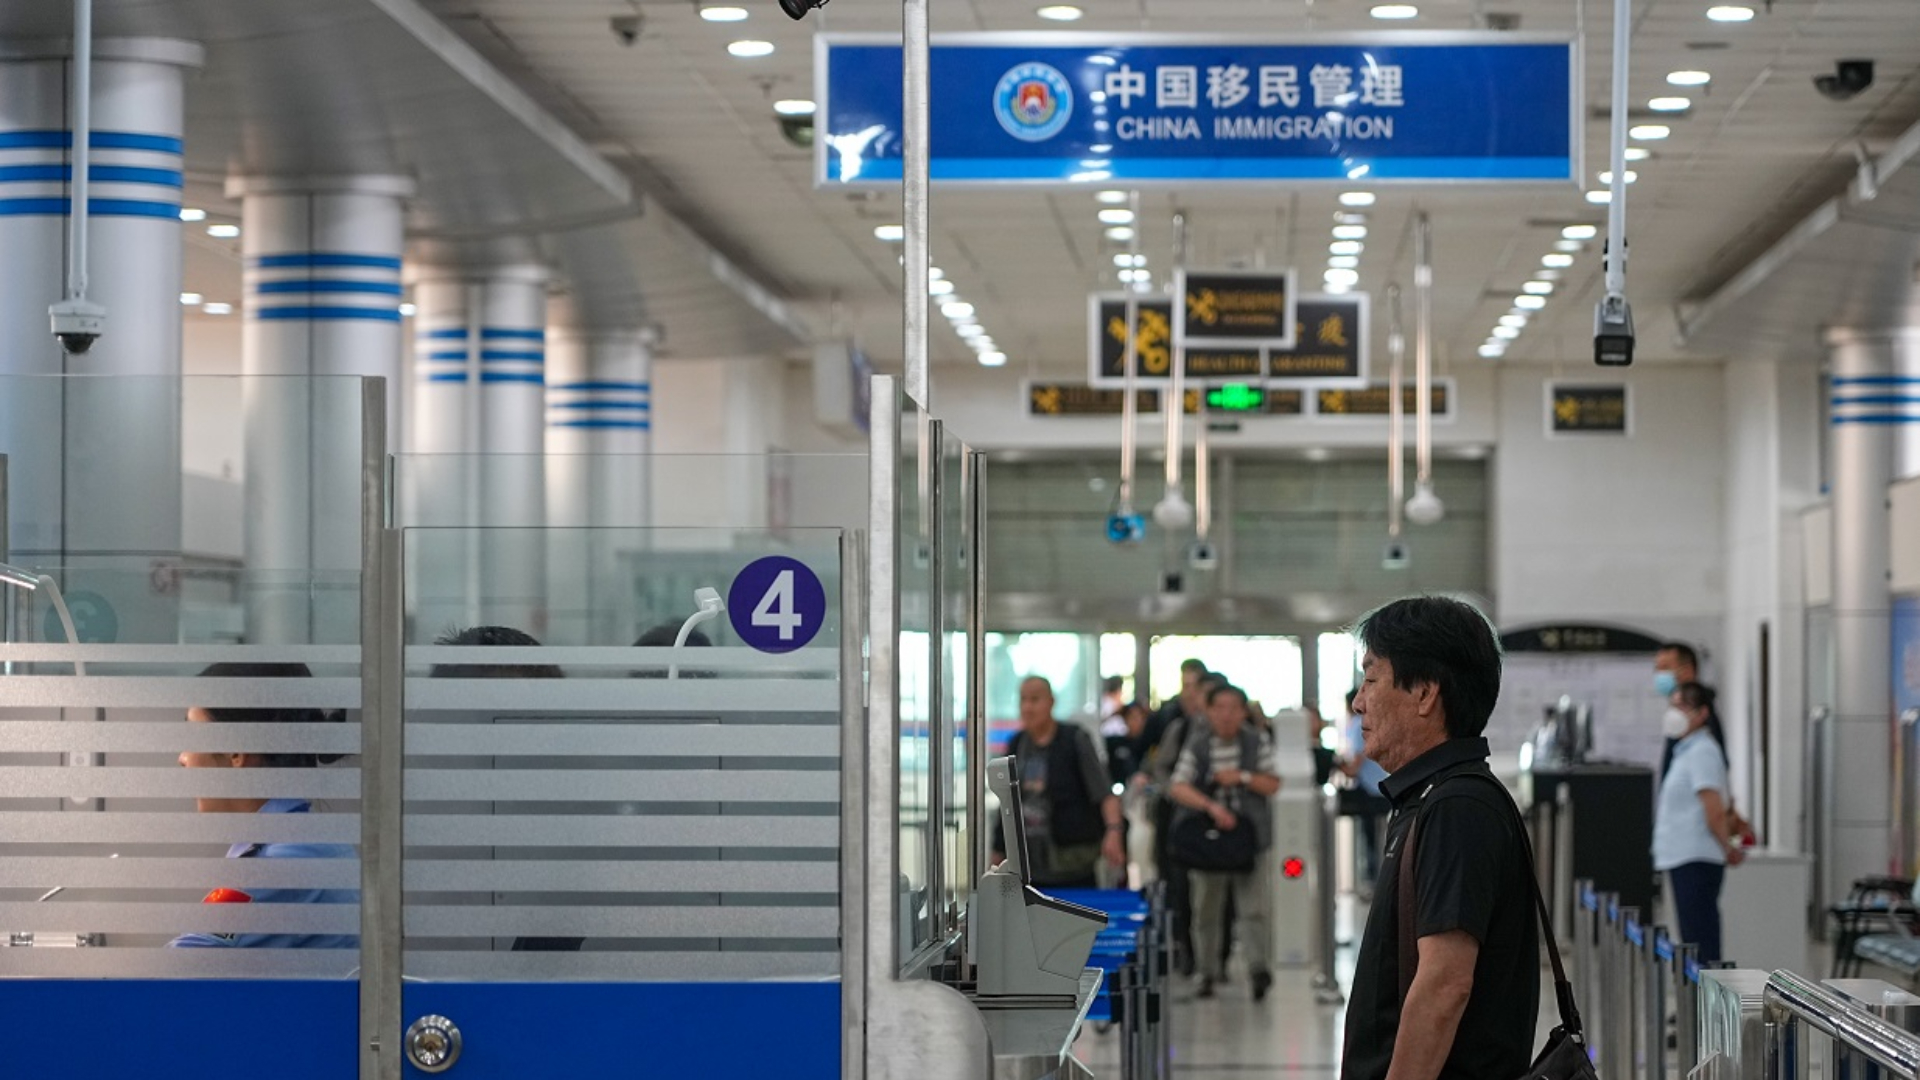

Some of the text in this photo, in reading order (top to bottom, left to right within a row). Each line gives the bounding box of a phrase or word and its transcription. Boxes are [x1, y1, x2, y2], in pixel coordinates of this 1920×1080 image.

[1105, 64, 1405, 109] 中国移民管理
[1116, 115, 1394, 140] CHINA IMMIGRATION
[751, 569, 802, 641] 4
